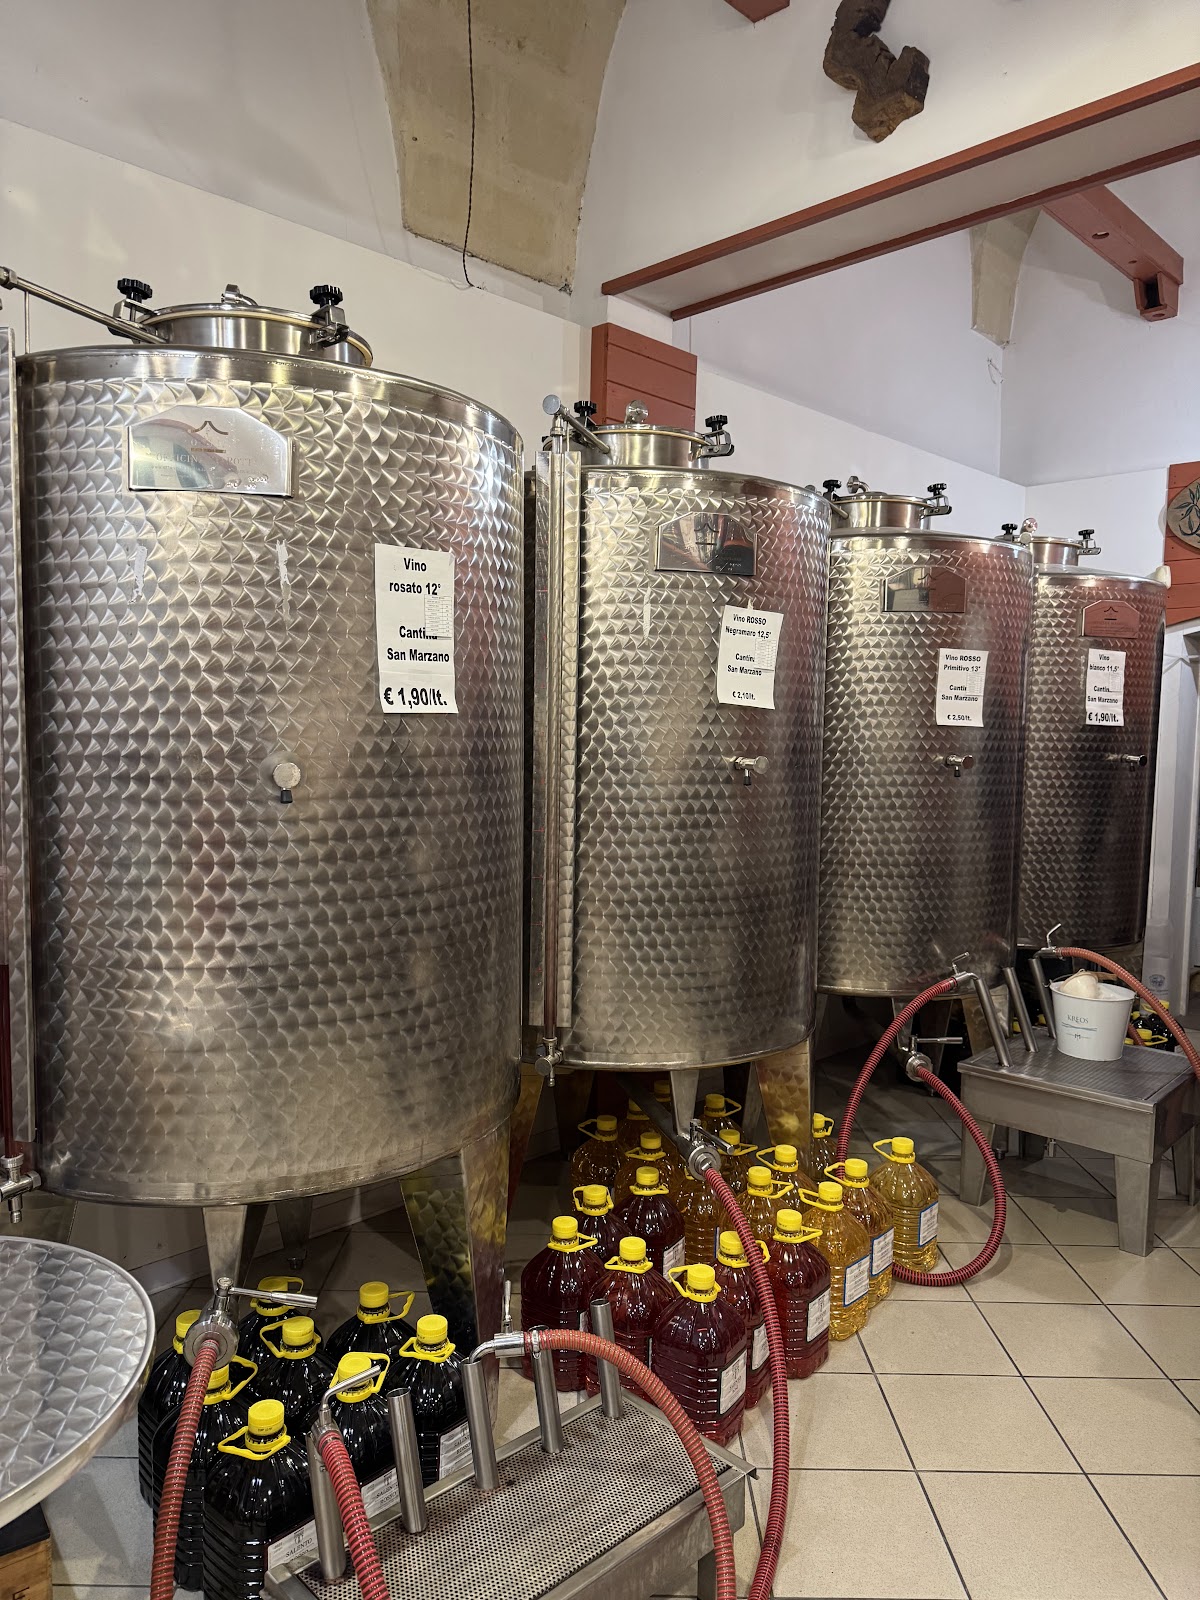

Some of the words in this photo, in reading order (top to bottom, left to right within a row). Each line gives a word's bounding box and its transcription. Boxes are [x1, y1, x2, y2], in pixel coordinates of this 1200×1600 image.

[403, 557, 427, 572] Vino
[389, 581, 422, 594] rosato
[425, 582, 441, 595] 12°
[733, 613, 745, 623] Vino
[746, 616, 767, 626] ROSSO
[725, 625, 756, 637] Negramaro
[387, 648, 406, 661] San
[409, 648, 450, 662] Marzano
[735, 653, 755, 663] Cantin
[727, 665, 738, 673] San
[739, 666, 762, 676] Marzano
[943, 664, 970, 672] Primitivo
[732, 690, 737, 698] €
[1093, 685, 1111, 693] Cantin
[383, 687, 394, 705] €
[397, 687, 447, 709] 1,90/lt.
[953, 694, 979, 702] Marzano
[1097, 696, 1119, 704] Marzano
[1088, 712, 1093, 721] €
[286, 1537, 313, 1558] SALENTO
